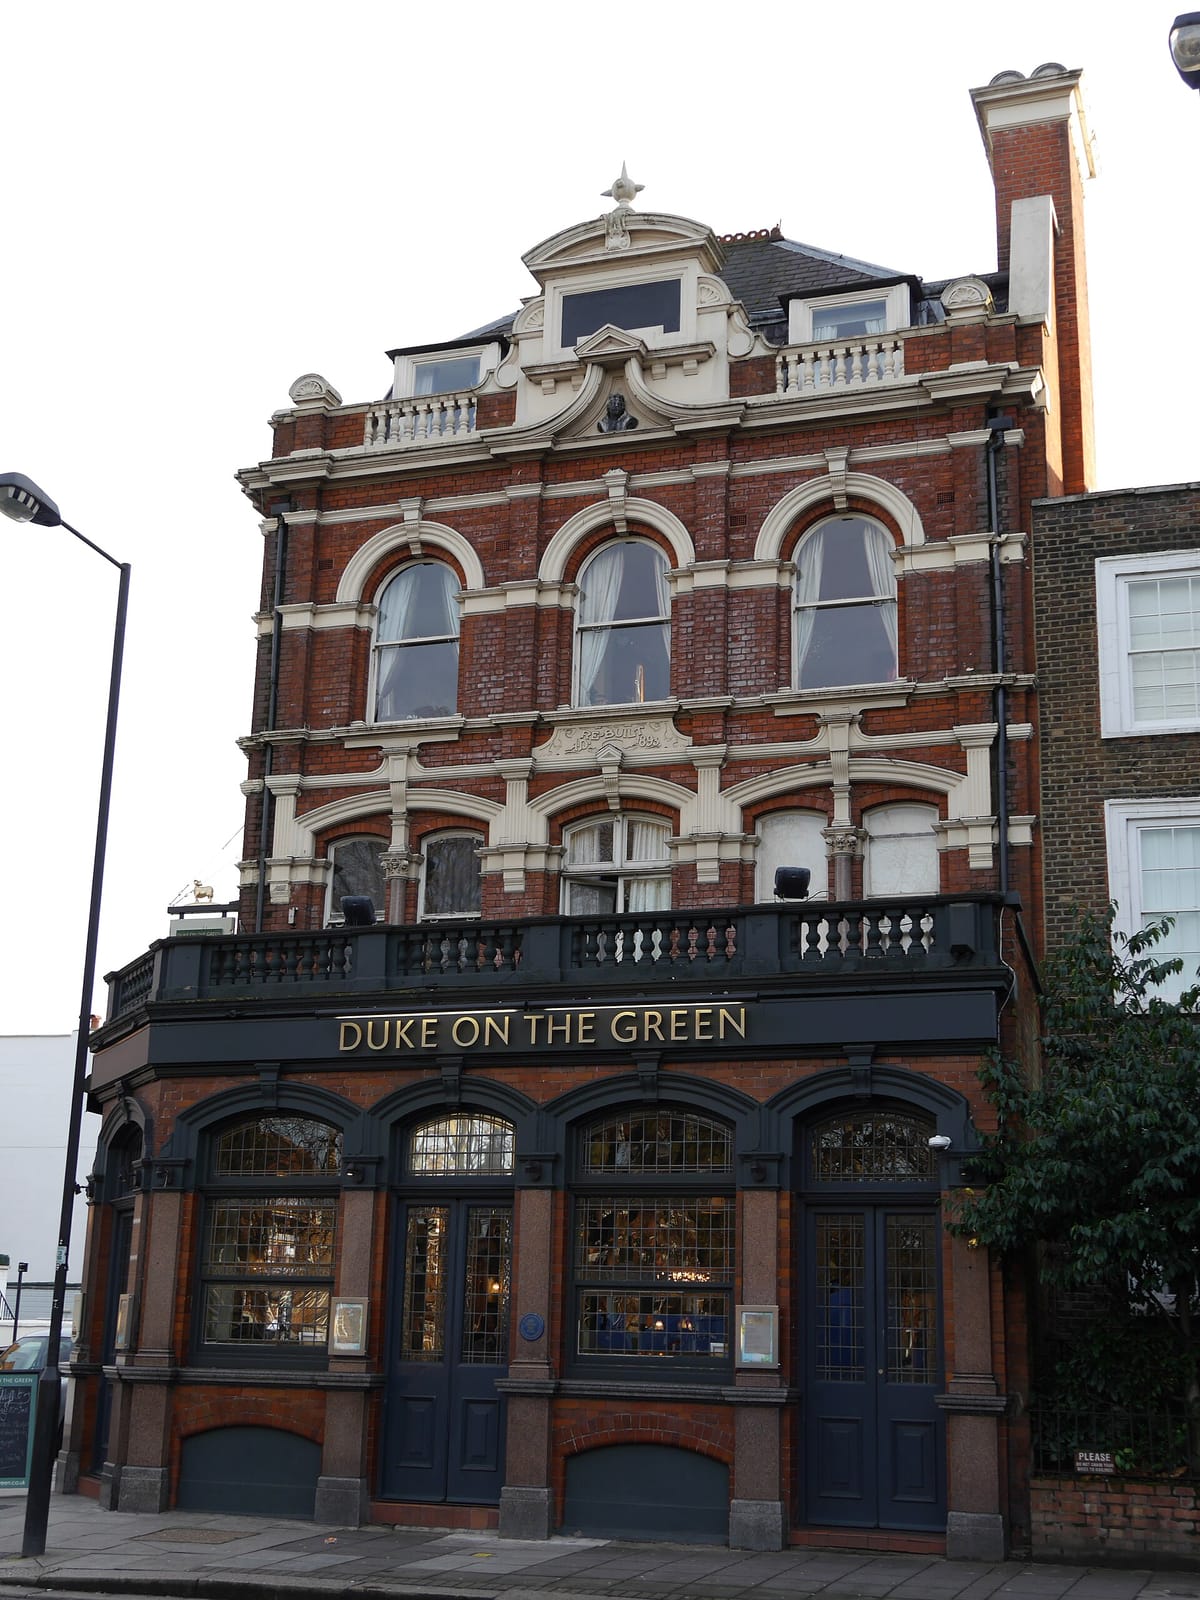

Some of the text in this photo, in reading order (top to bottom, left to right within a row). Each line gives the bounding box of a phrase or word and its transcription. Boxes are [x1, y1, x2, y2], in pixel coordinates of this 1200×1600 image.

[338, 1007, 747, 1051] DUKE ON THE GREEN
[1078, 1452, 1111, 1462] PLEASE
